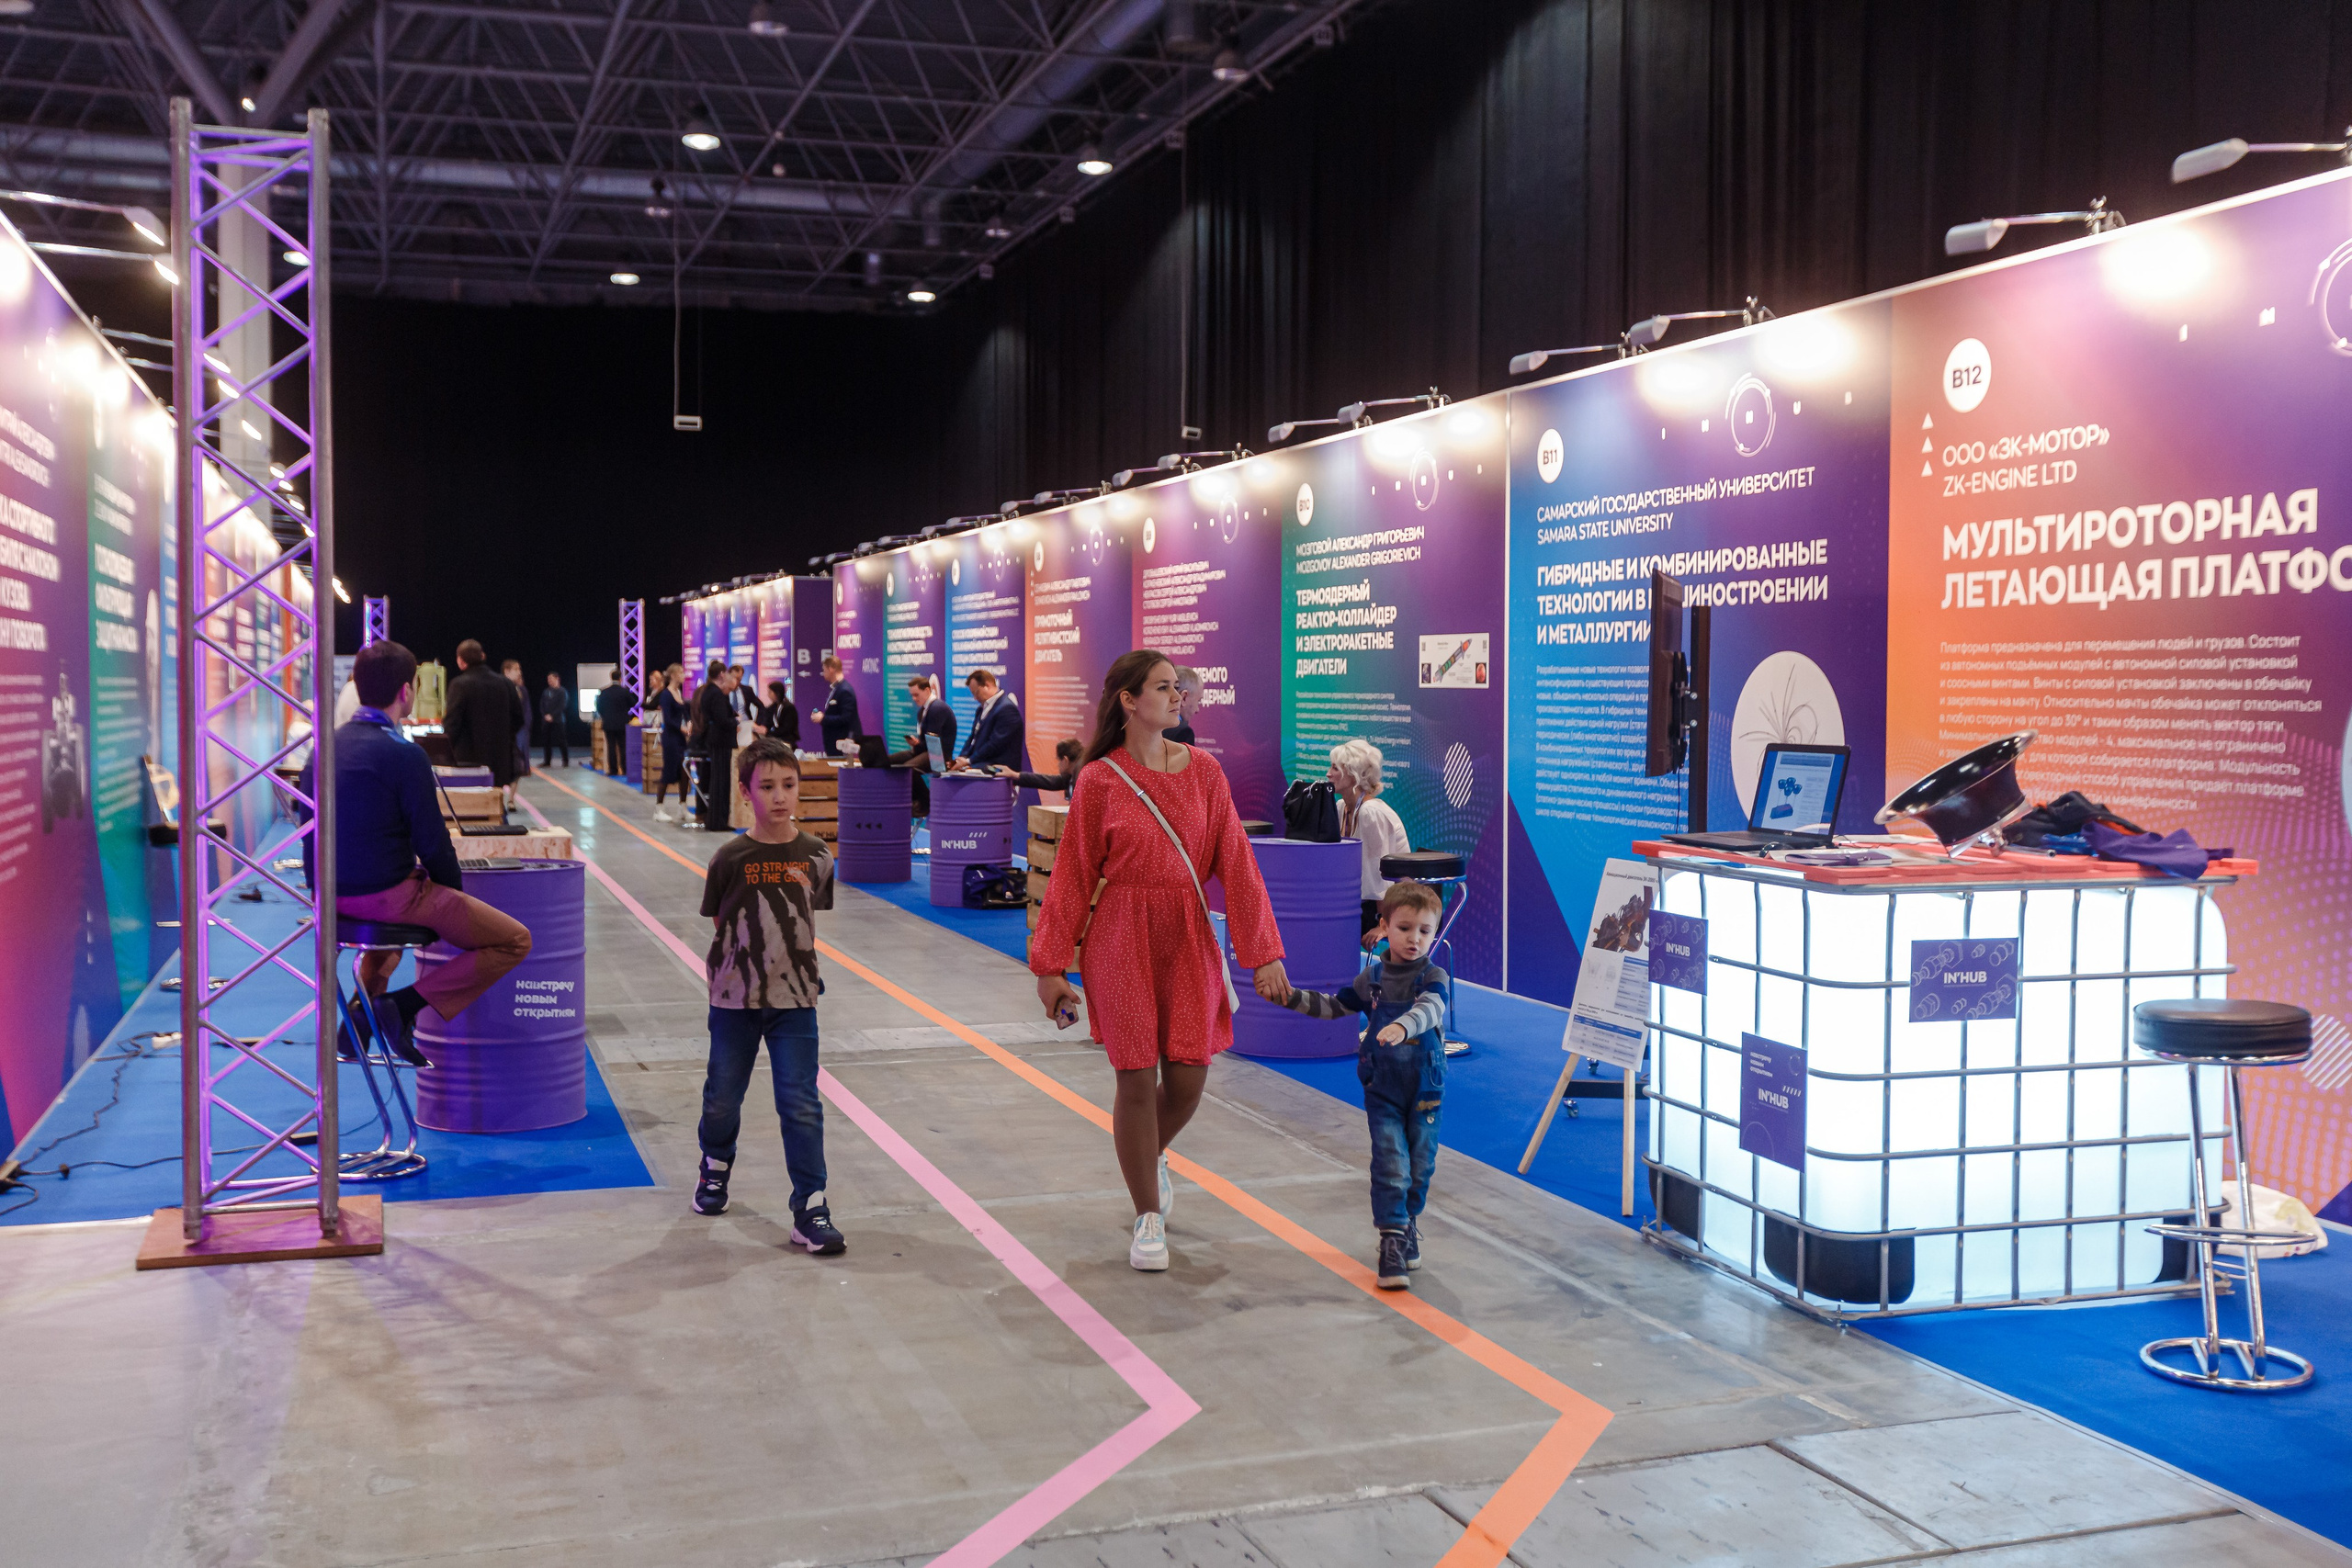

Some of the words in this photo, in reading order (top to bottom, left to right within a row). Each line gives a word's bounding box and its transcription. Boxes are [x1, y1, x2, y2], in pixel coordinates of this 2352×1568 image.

[1952, 366, 1982, 389] B12
[1544, 448, 1557, 465] B11
[1942, 441, 1985, 467] ООО
[1942, 464, 2038, 497] ZK-ENGINE
[2041, 459, 2077, 486] LTD
[1536, 495, 1599, 524] САМАРСКИЙ
[1601, 478, 1716, 513] ГОСУДАРСТВЕННЫЙ
[1718, 466, 1815, 499] УНИВЕРСИТЕТ
[1538, 525, 1577, 546] SAMARA
[1579, 520, 1610, 540] STATE
[1611, 513, 1674, 537] UNIVERSITY
[1943, 488, 2319, 560] МУЛЬТИРОТОРНАЯ
[1537, 558, 1624, 588] ГИБРИДНЫЕ
[1626, 557, 1638, 581] И
[1640, 538, 1828, 578] КОМБИНИРОВАННЫЕ
[1295, 579, 1370, 606] ТЕРМОЯДЕРНЫЙ
[1940, 558, 2163, 611] ЛЕТАЮЩАЯ
[1537, 588, 1634, 615] ТЕХНОЛОГИИ
[1635, 588, 1646, 610] В
[1296, 603, 1396, 629] РЕАКТОР-КОЛЛАЙДЕР
[1305, 631, 1394, 652] ЭЛЕКТРОРАКЕТНЫЕ
[1537, 625, 1547, 645] И
[1295, 658, 1347, 678] ДВИГАТЕЛИ
[941, 840, 978, 850] IN'HUB
[744, 863, 761, 874] GO
[763, 861, 810, 873] STRAIGHT
[746, 874, 759, 886] TO
[763, 873, 781, 884] THE
[1667, 942, 1690, 957] IN'HUB
[1944, 971, 1987, 984] IN'HUB
[514, 994, 557, 1004] новым
[514, 1008, 575, 1020] открытиям
[1758, 1088, 1789, 1109] IN'HUB
